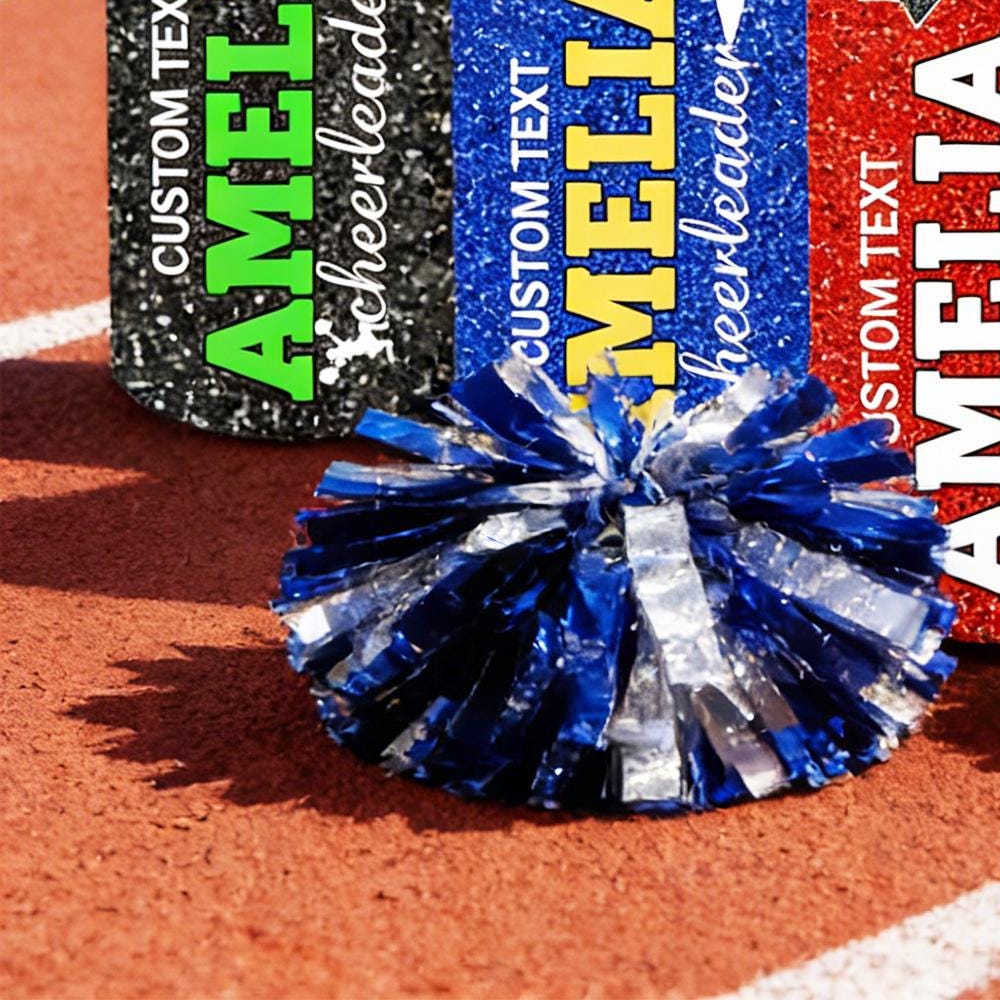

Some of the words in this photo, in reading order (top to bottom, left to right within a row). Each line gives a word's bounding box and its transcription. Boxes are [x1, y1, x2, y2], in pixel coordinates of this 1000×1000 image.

[149, 93, 190, 276] CUSTOM
[510, 57, 550, 166] TEXT
[510, 181, 550, 367] CUSTOM
[678, 41, 755, 384] heerleader
[859, 151, 900, 268] TEXT
[859, 278, 901, 444] USTOM
